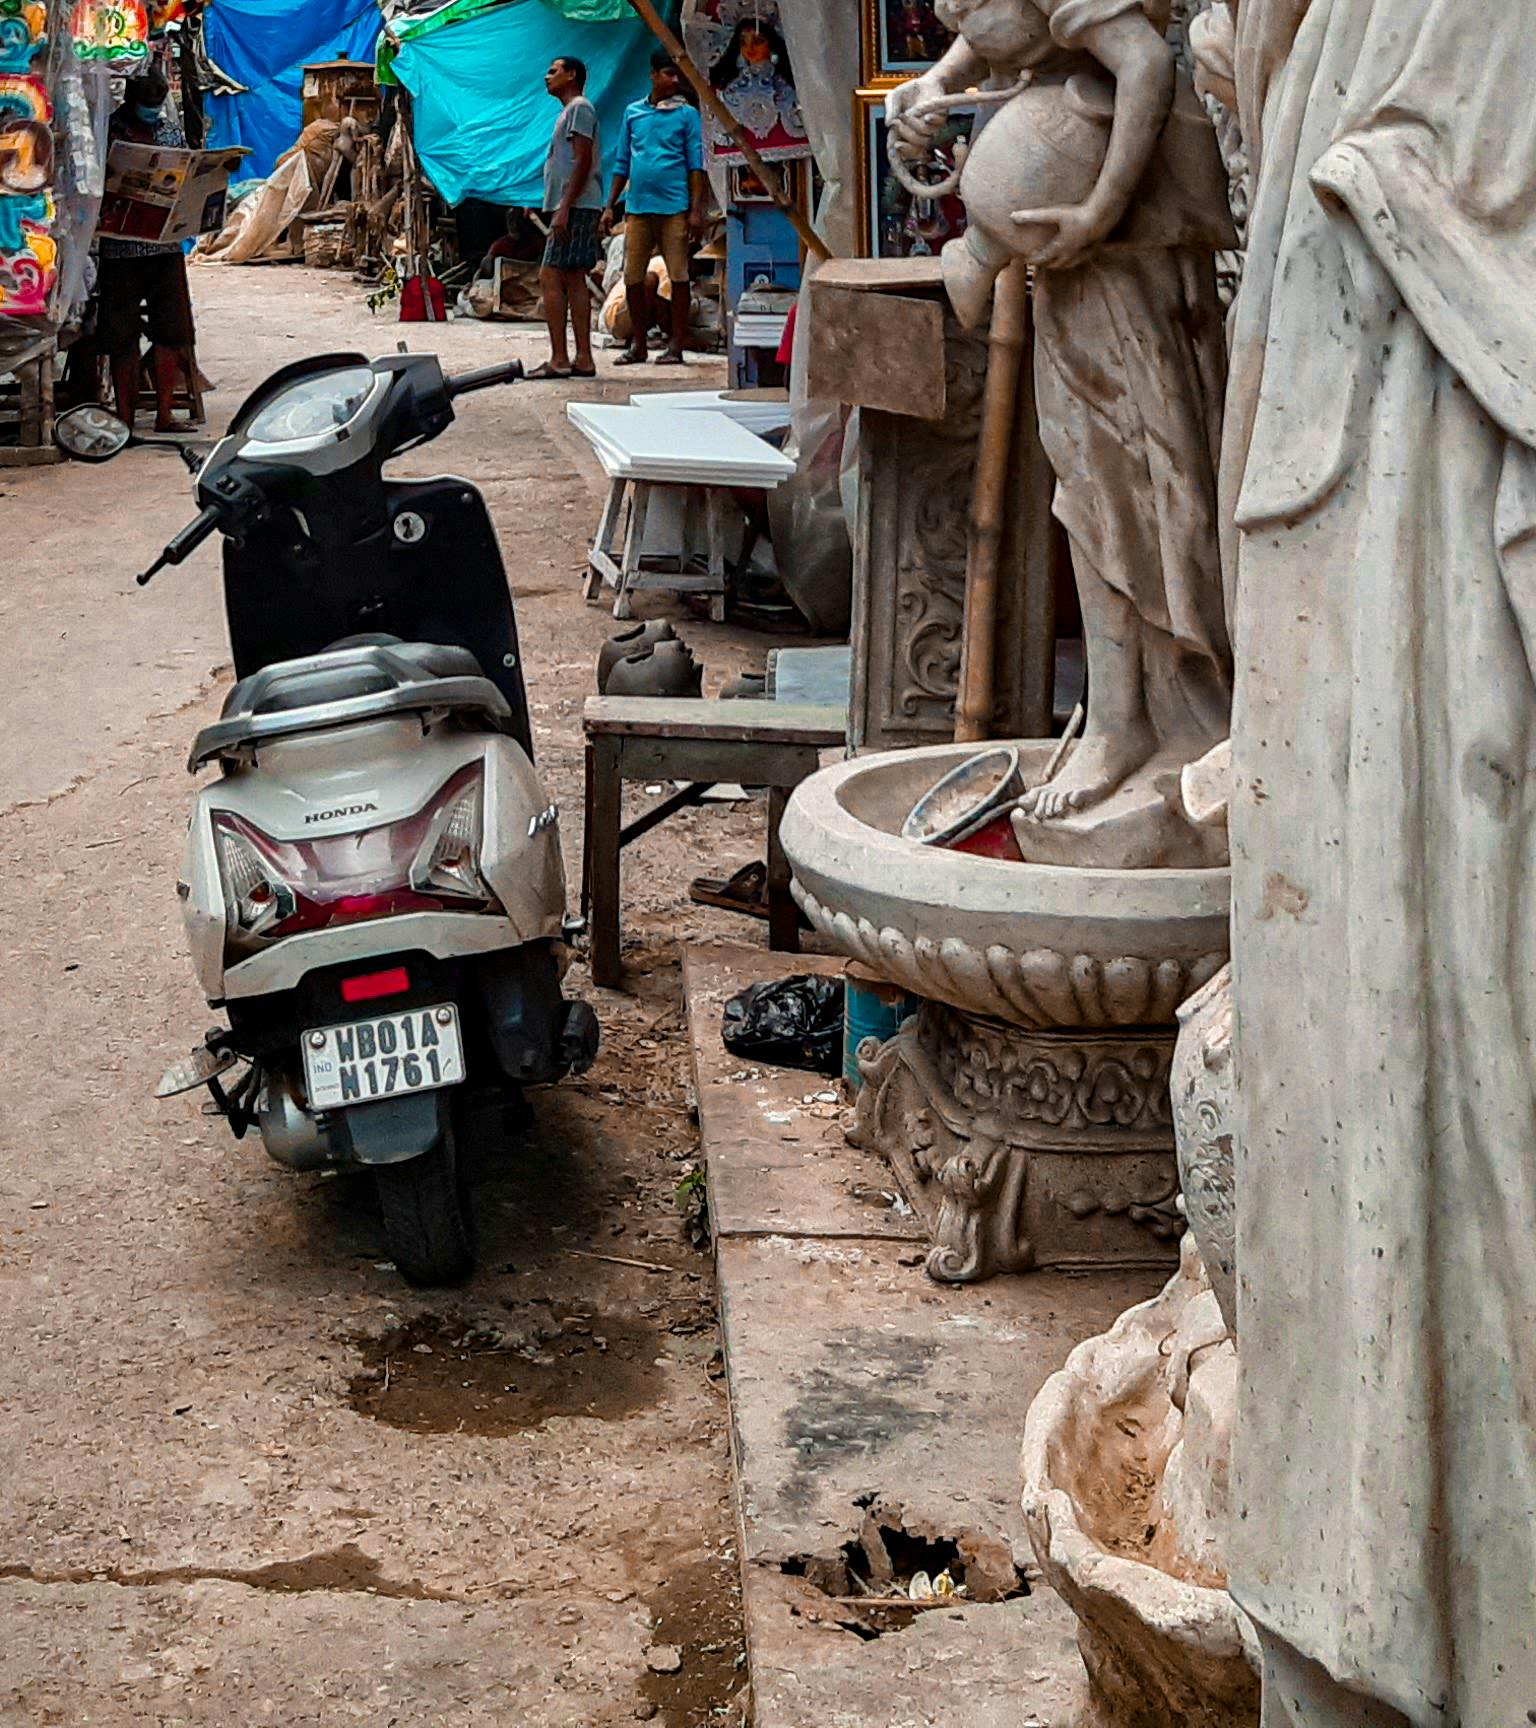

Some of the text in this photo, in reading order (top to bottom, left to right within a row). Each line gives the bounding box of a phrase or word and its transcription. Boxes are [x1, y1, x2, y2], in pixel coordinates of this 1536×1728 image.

[304, 802, 378, 824] HONDA
[335, 1012, 440, 1063] WB01A
[339, 1048, 441, 1101] N1761
